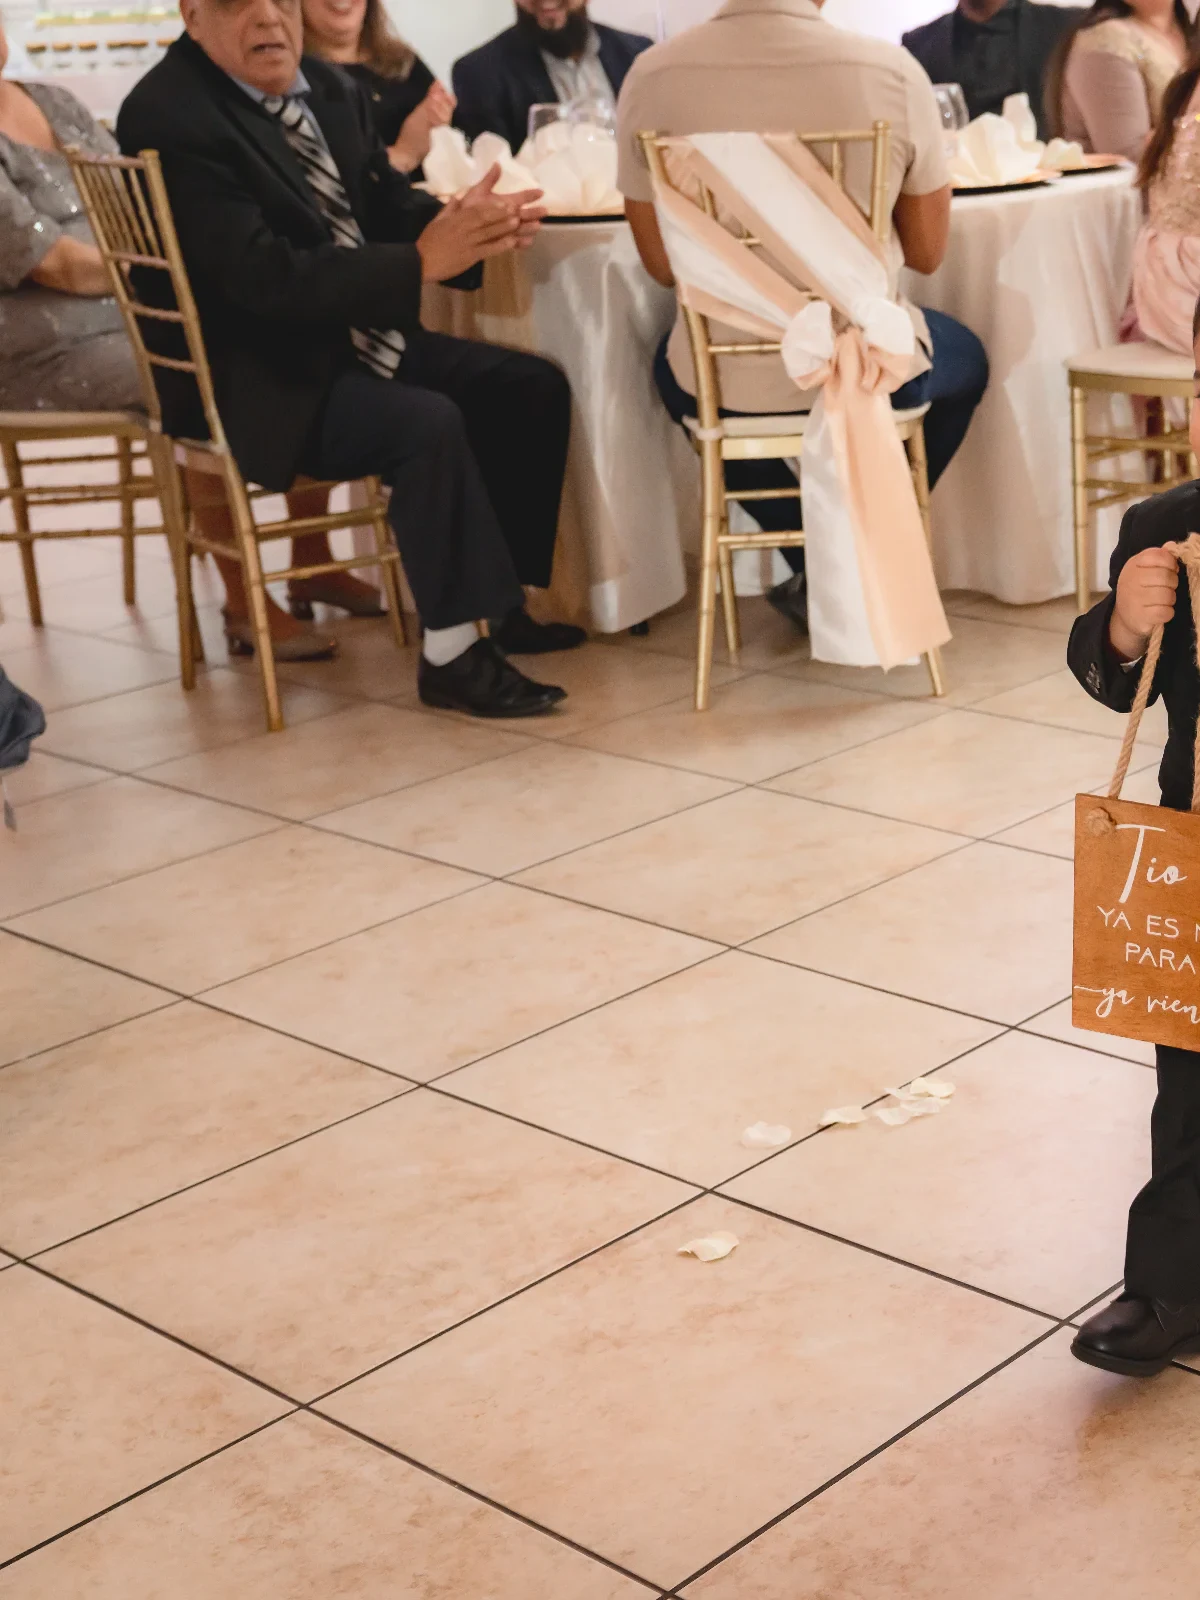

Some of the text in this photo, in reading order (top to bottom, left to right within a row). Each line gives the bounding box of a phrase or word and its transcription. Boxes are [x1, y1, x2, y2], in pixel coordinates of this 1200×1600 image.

[1116, 823, 1188, 904] Tio
[1097, 905, 1132, 931] YA
[1146, 914, 1180, 939] ES
[1125, 942, 1196, 975] PARA
[1074, 985, 1135, 1018] ya
